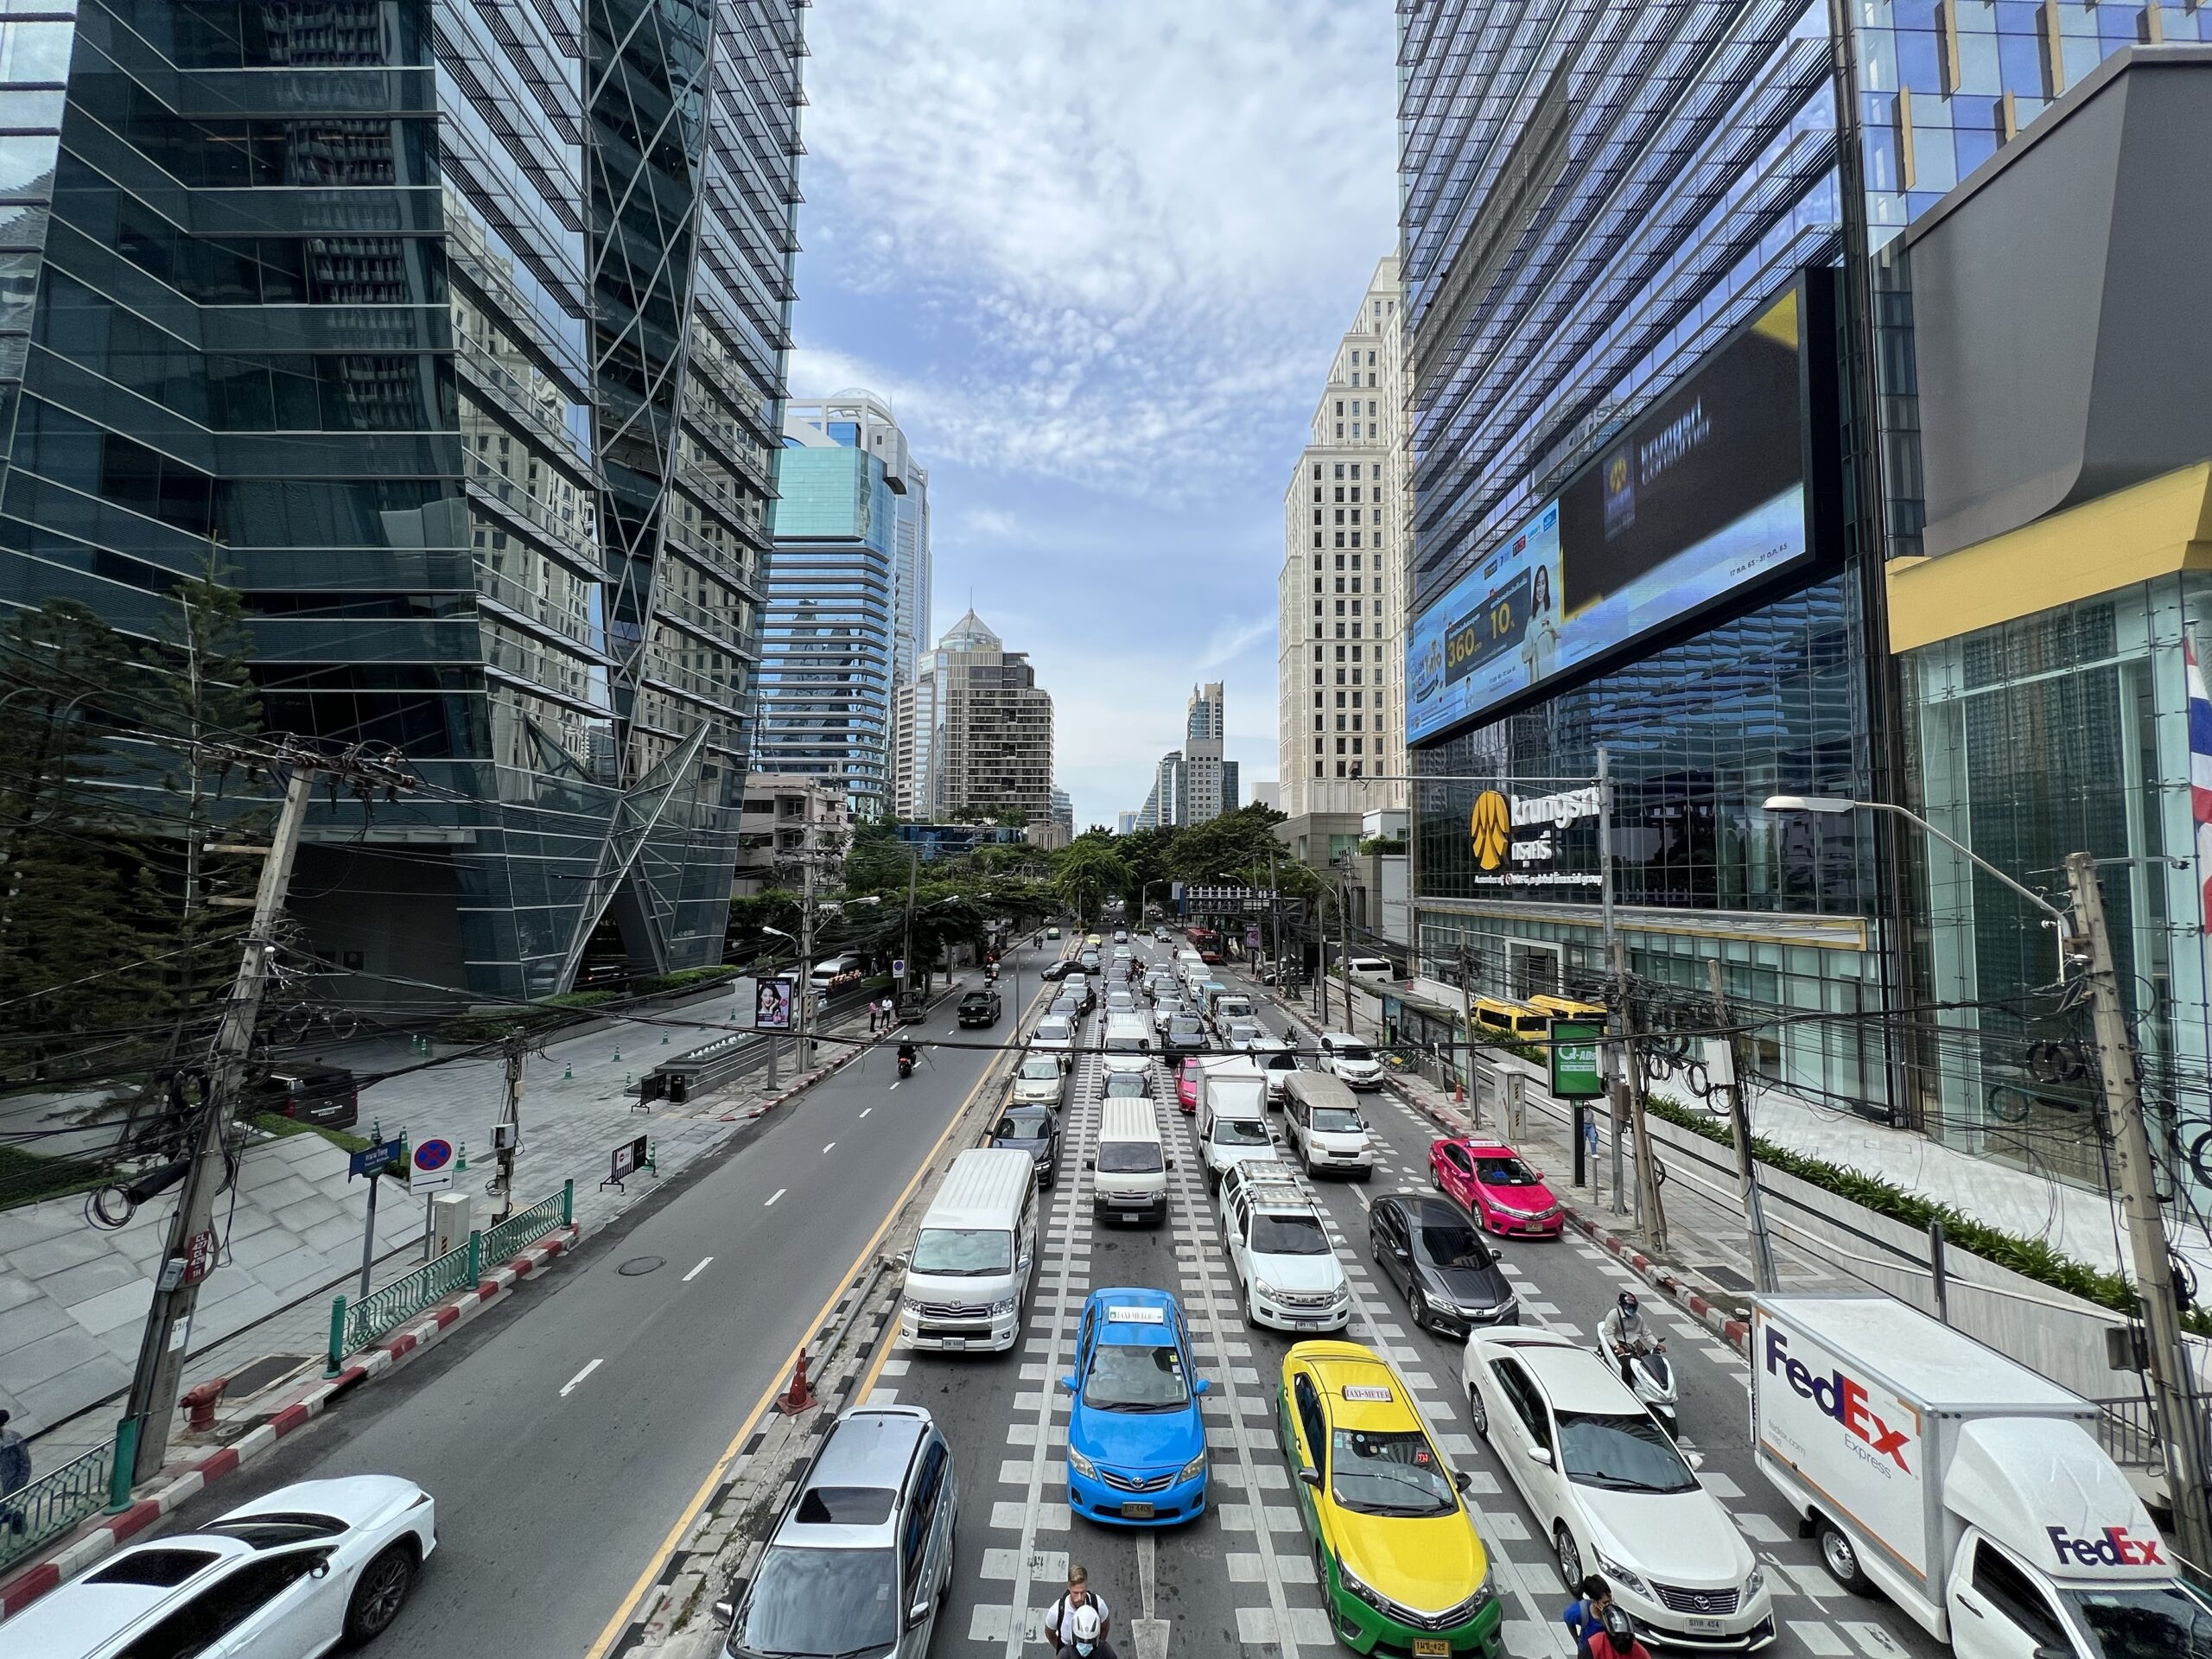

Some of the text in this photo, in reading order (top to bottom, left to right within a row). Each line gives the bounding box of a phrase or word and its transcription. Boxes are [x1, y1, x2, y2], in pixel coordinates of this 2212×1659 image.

[1491, 603, 1510, 639] 10
[1448, 628, 1474, 668] 360
[1346, 1389, 1390, 1399] TAXI-METER
[1765, 1325, 1912, 1476] FedEx
[1768, 1418, 1806, 1458] fedex.com
[1845, 1433, 1891, 1479] Express
[2045, 1526, 2167, 1567] FedEx
